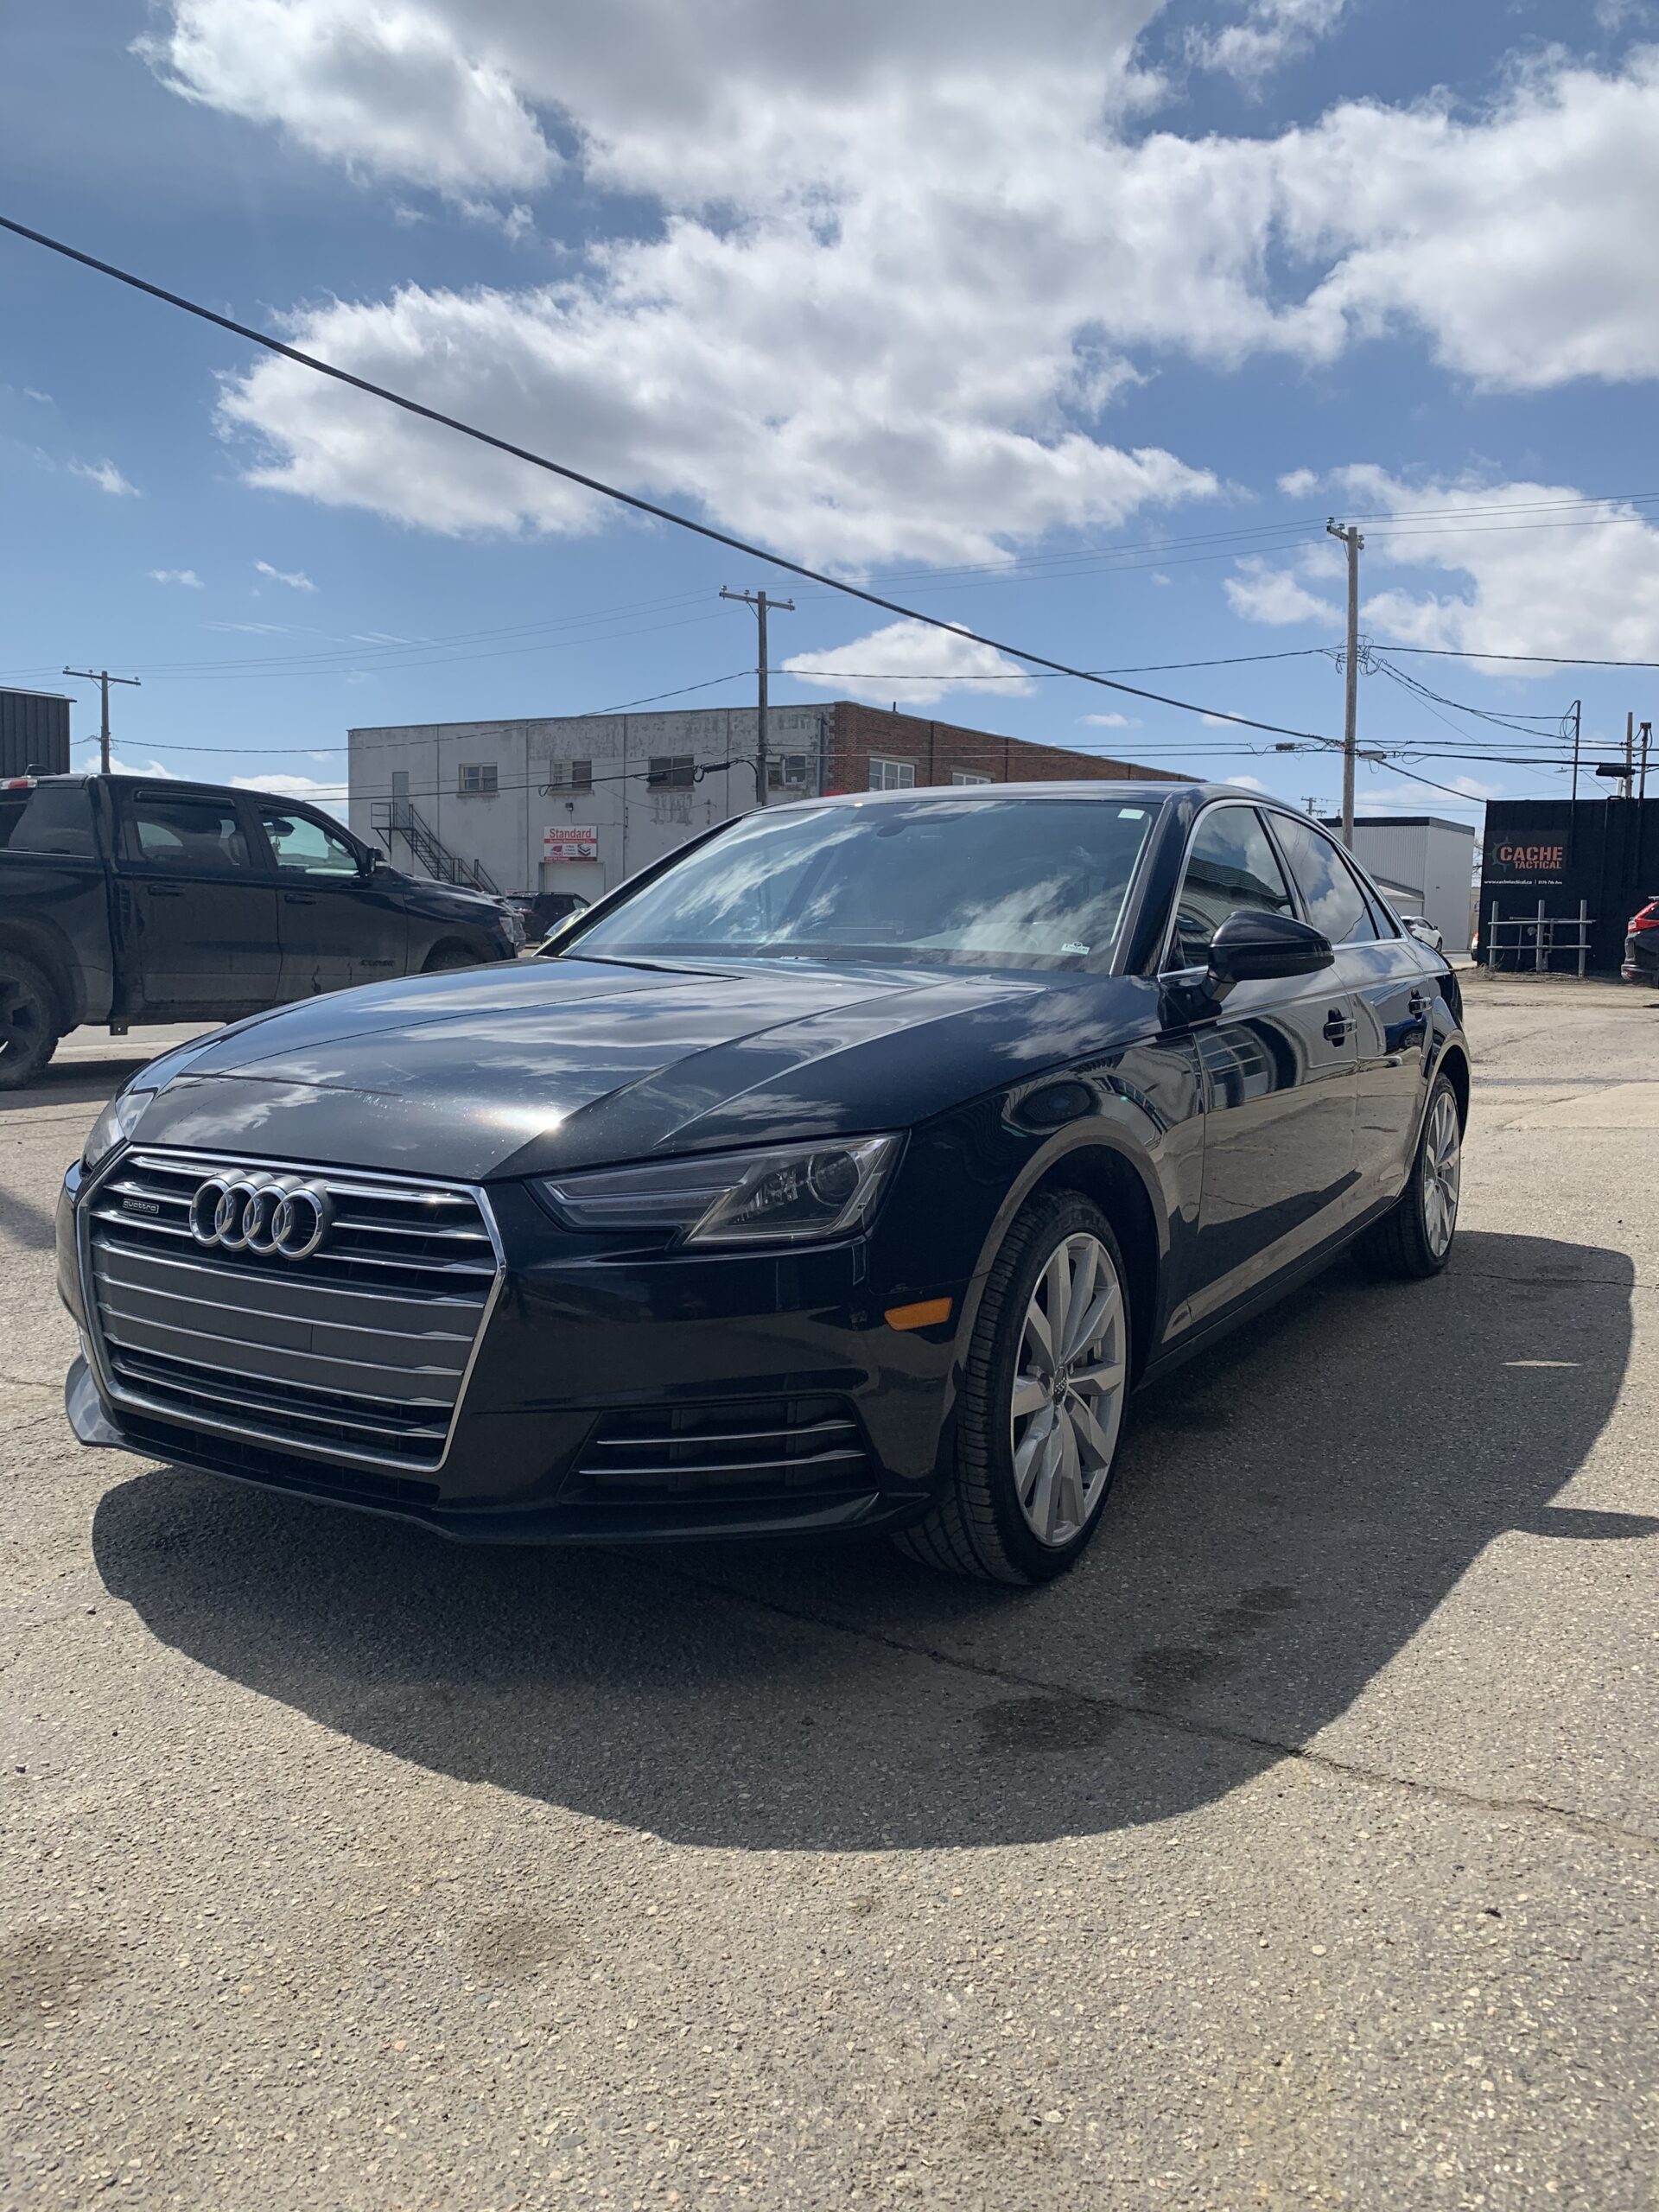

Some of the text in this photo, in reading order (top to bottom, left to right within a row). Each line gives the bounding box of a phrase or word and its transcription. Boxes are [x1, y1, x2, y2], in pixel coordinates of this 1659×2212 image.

[550, 828, 591, 838] Standard
[1500, 846, 1563, 861] CACHE
[1513, 861, 1562, 869] TACTICAL
[123, 1200, 156, 1211] quattro
